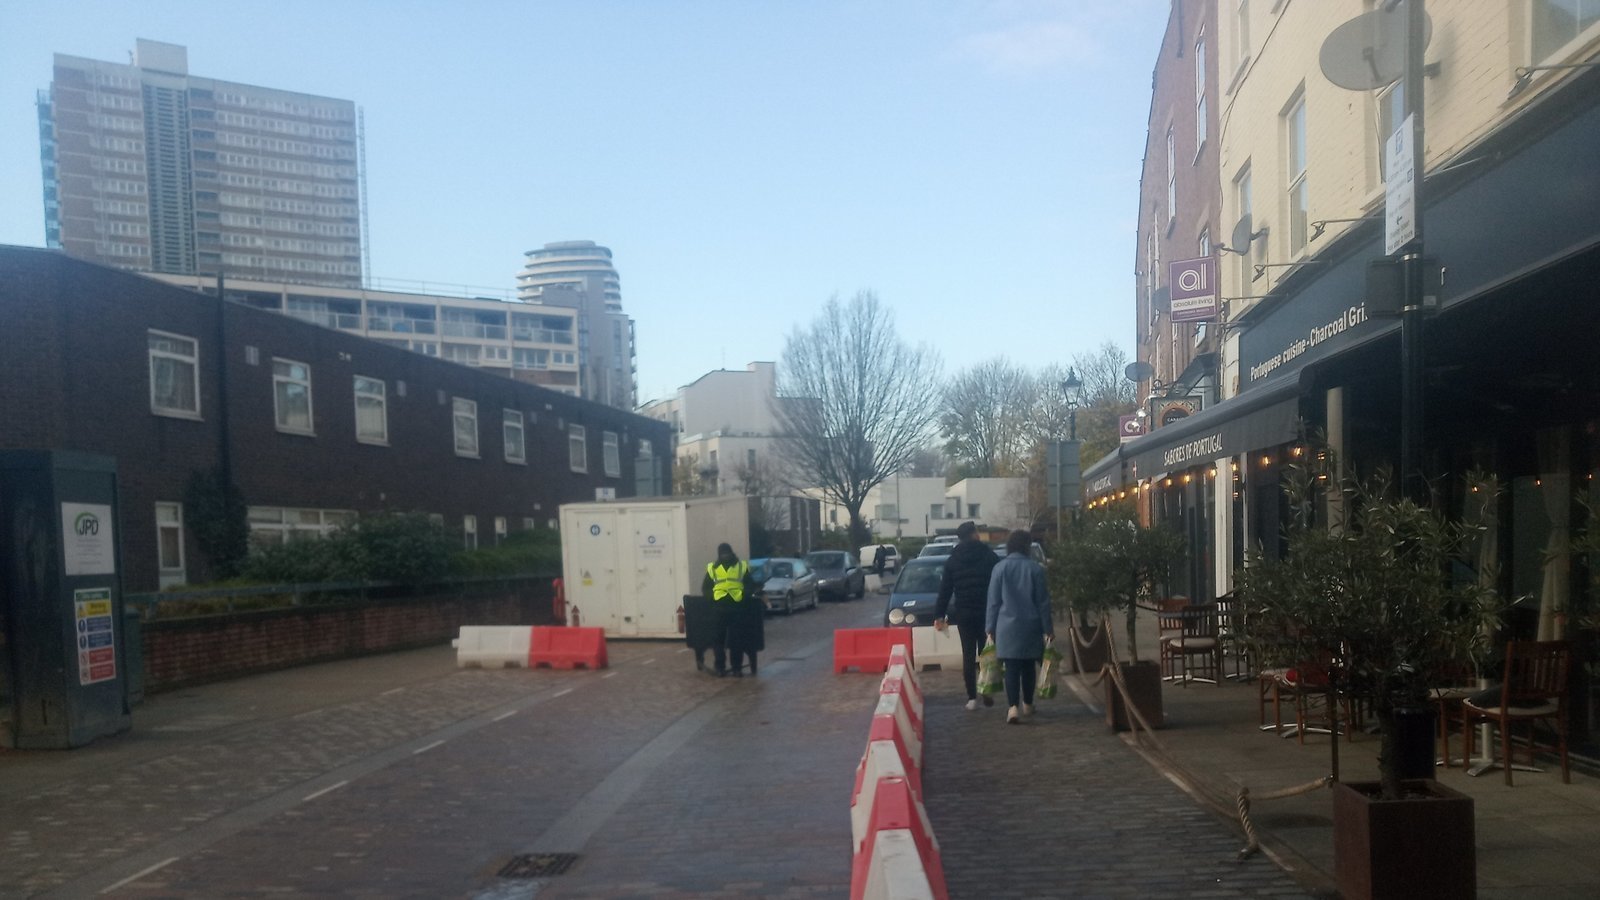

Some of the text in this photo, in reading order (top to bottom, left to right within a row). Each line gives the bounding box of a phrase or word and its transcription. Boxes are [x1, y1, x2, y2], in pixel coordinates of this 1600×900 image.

[1250, 354, 1282, 382] Portuguese
[1283, 339, 1306, 363] cuisine
[1310, 311, 1347, 347] Charcoal
[1348, 302, 1368, 327] Gri
[1186, 442, 1192, 460] DE
[1193, 433, 1223, 457] PORTUGAL
[79, 519, 99, 536] JPD
